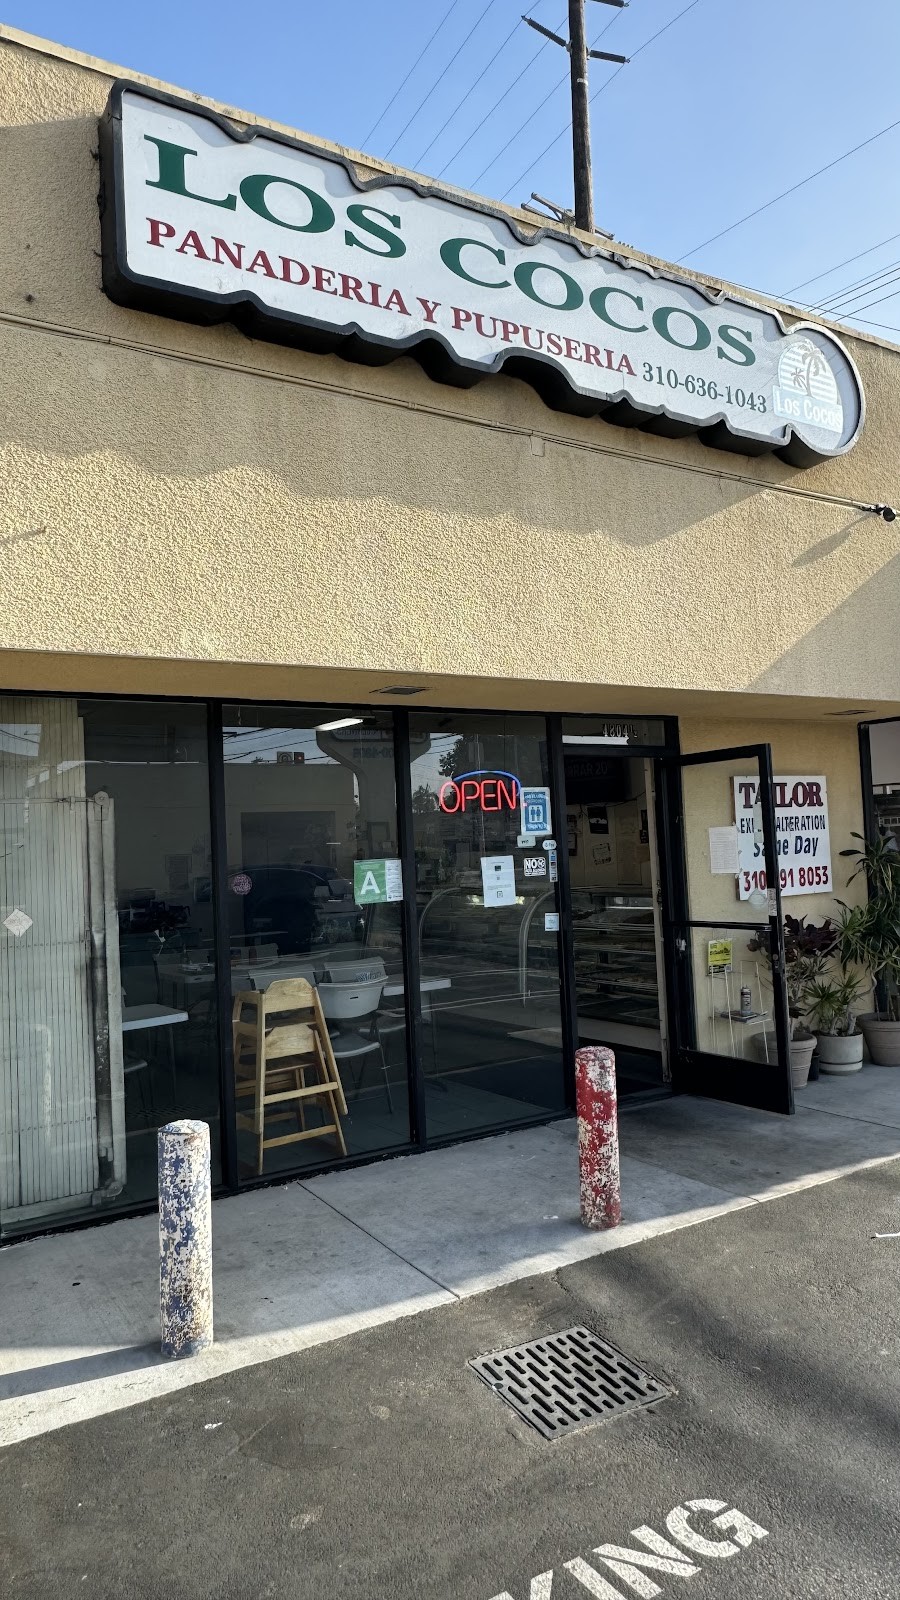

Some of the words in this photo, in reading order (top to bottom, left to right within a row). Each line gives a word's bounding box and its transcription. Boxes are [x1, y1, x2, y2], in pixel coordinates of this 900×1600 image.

[143, 134, 407, 259] LOS
[439, 237, 756, 367] COCOS
[145, 217, 412, 316] PANADERIA
[416, 297, 442, 323] Y
[451, 306, 637, 376] PUPUSERIA
[642, 362, 767, 414] 310-636-1043
[776, 389, 800, 416] Los
[803, 403, 842, 427] Cocos
[439, 779, 518, 813] OPEN
[776, 814, 826, 833] ALTERATION
[794, 835, 819, 857] Day
[360, 870, 381, 895] A
[743, 870, 767, 892] 310
[798, 865, 829, 888] 8053
